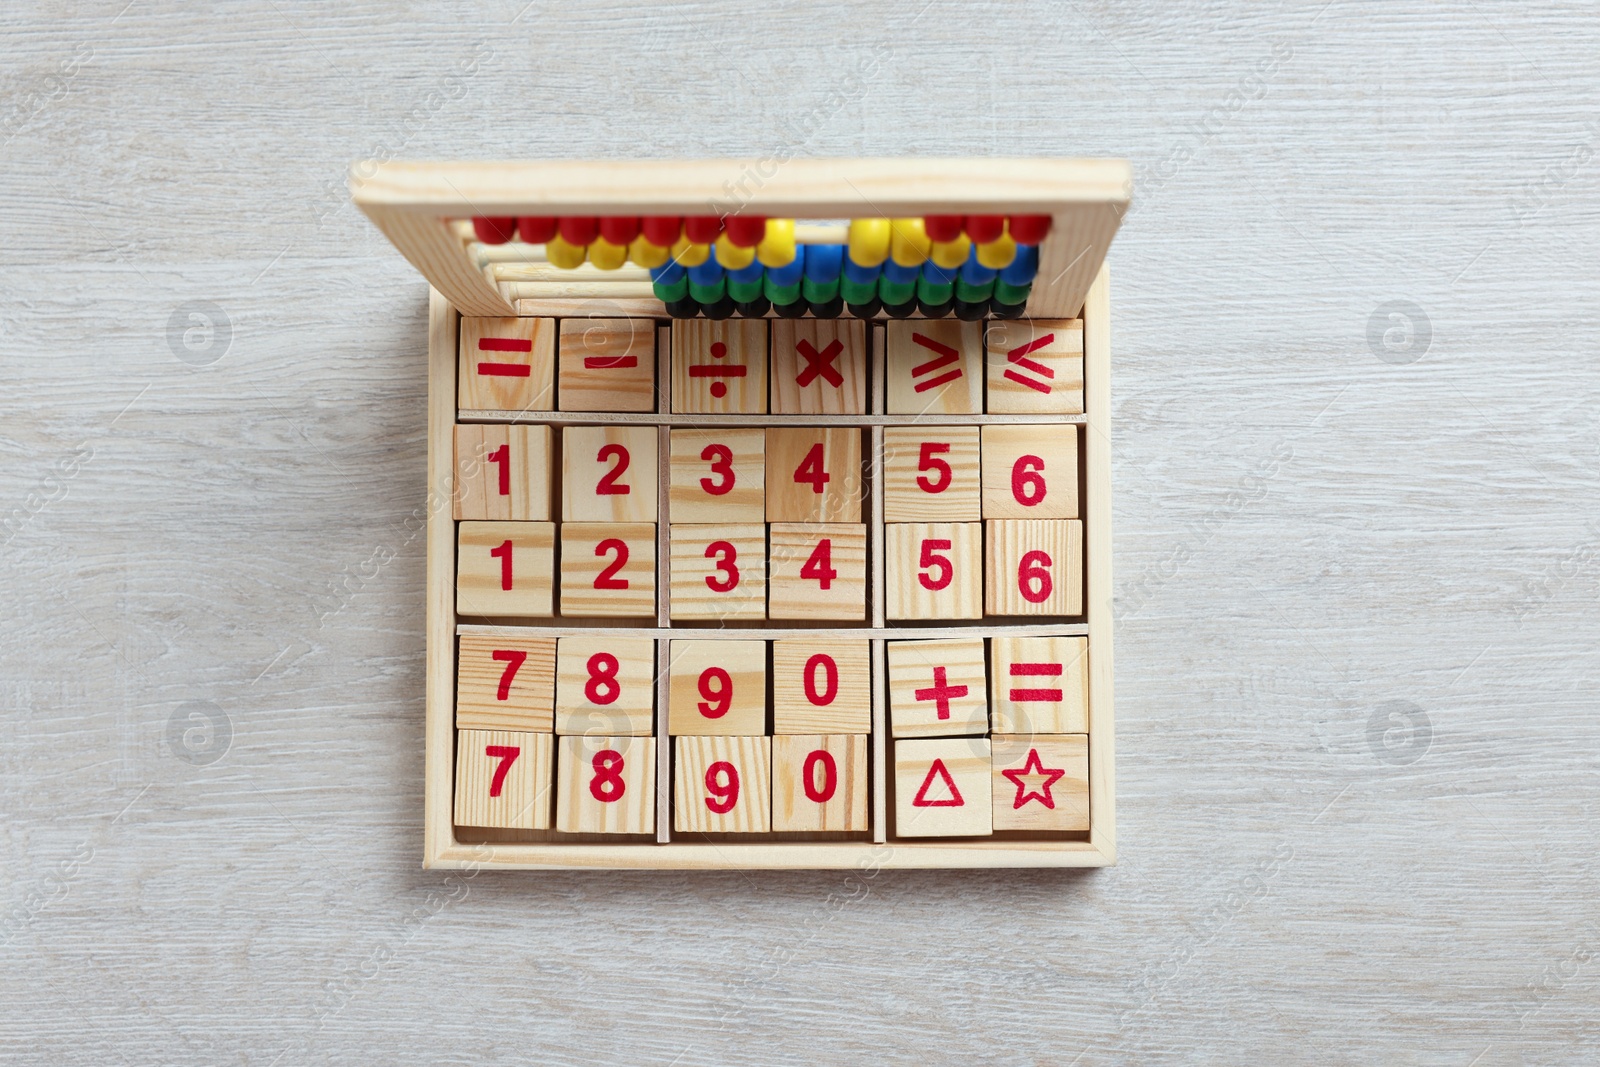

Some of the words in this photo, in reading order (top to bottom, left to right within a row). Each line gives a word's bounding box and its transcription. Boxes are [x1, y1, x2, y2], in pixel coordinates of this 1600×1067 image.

[488, 445, 510, 495] 1
[596, 444, 630, 495] 2
[700, 444, 735, 495] 3
[794, 443, 830, 494] 4
[917, 443, 951, 493] 5
[1012, 455, 1046, 506] 6
[490, 540, 512, 590] 1
[594, 538, 629, 589] 2
[705, 541, 739, 592] 3
[801, 539, 836, 589] 4
[918, 540, 952, 590] 5
[1018, 551, 1052, 602] 6
[492, 650, 527, 700] 7
[585, 653, 620, 704] 8
[698, 667, 733, 719] 9
[804, 654, 838, 706] 0
[486, 746, 520, 797] 7
[590, 750, 625, 802] 8
[705, 762, 739, 814] 9
[803, 750, 837, 803] 0
